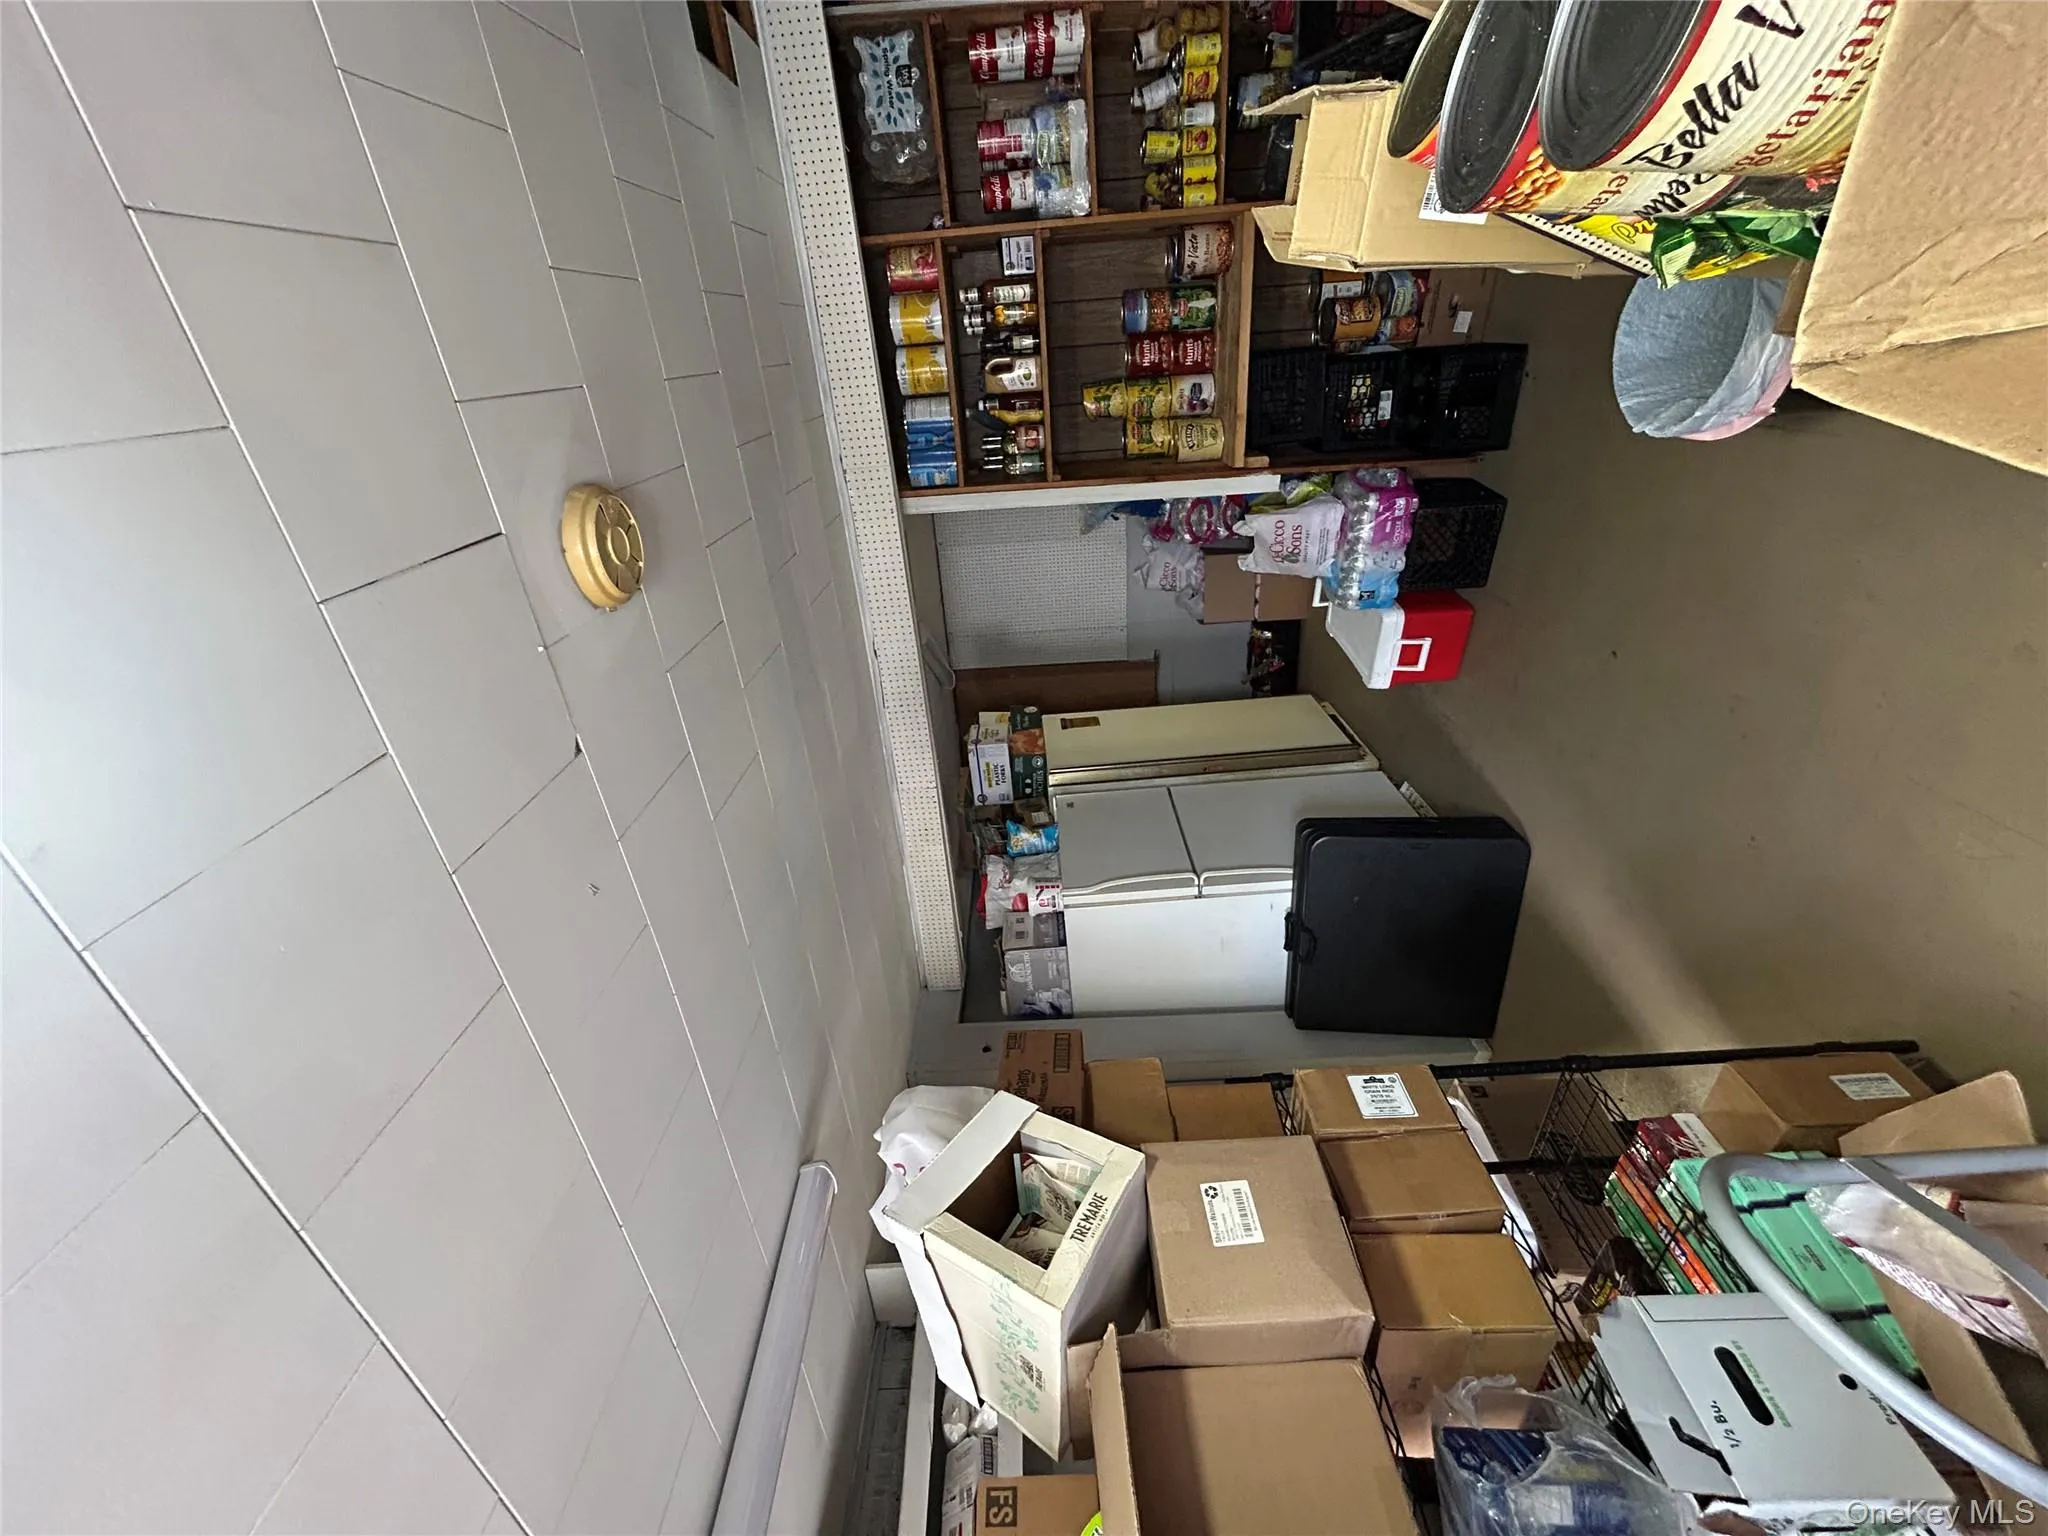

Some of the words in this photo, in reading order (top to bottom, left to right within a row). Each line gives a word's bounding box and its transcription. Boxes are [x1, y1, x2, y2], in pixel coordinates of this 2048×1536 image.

[881, 47, 893, 77] Spring
[884, 79, 896, 109] Water
[1621, 52, 1760, 169] Bella
[1187, 233, 1199, 258] Vista
[1070, 1192, 1108, 1243] TREMARIE
[1710, 1400, 1728, 1424] Bu.
[1722, 1428, 1742, 1449] 1/2
